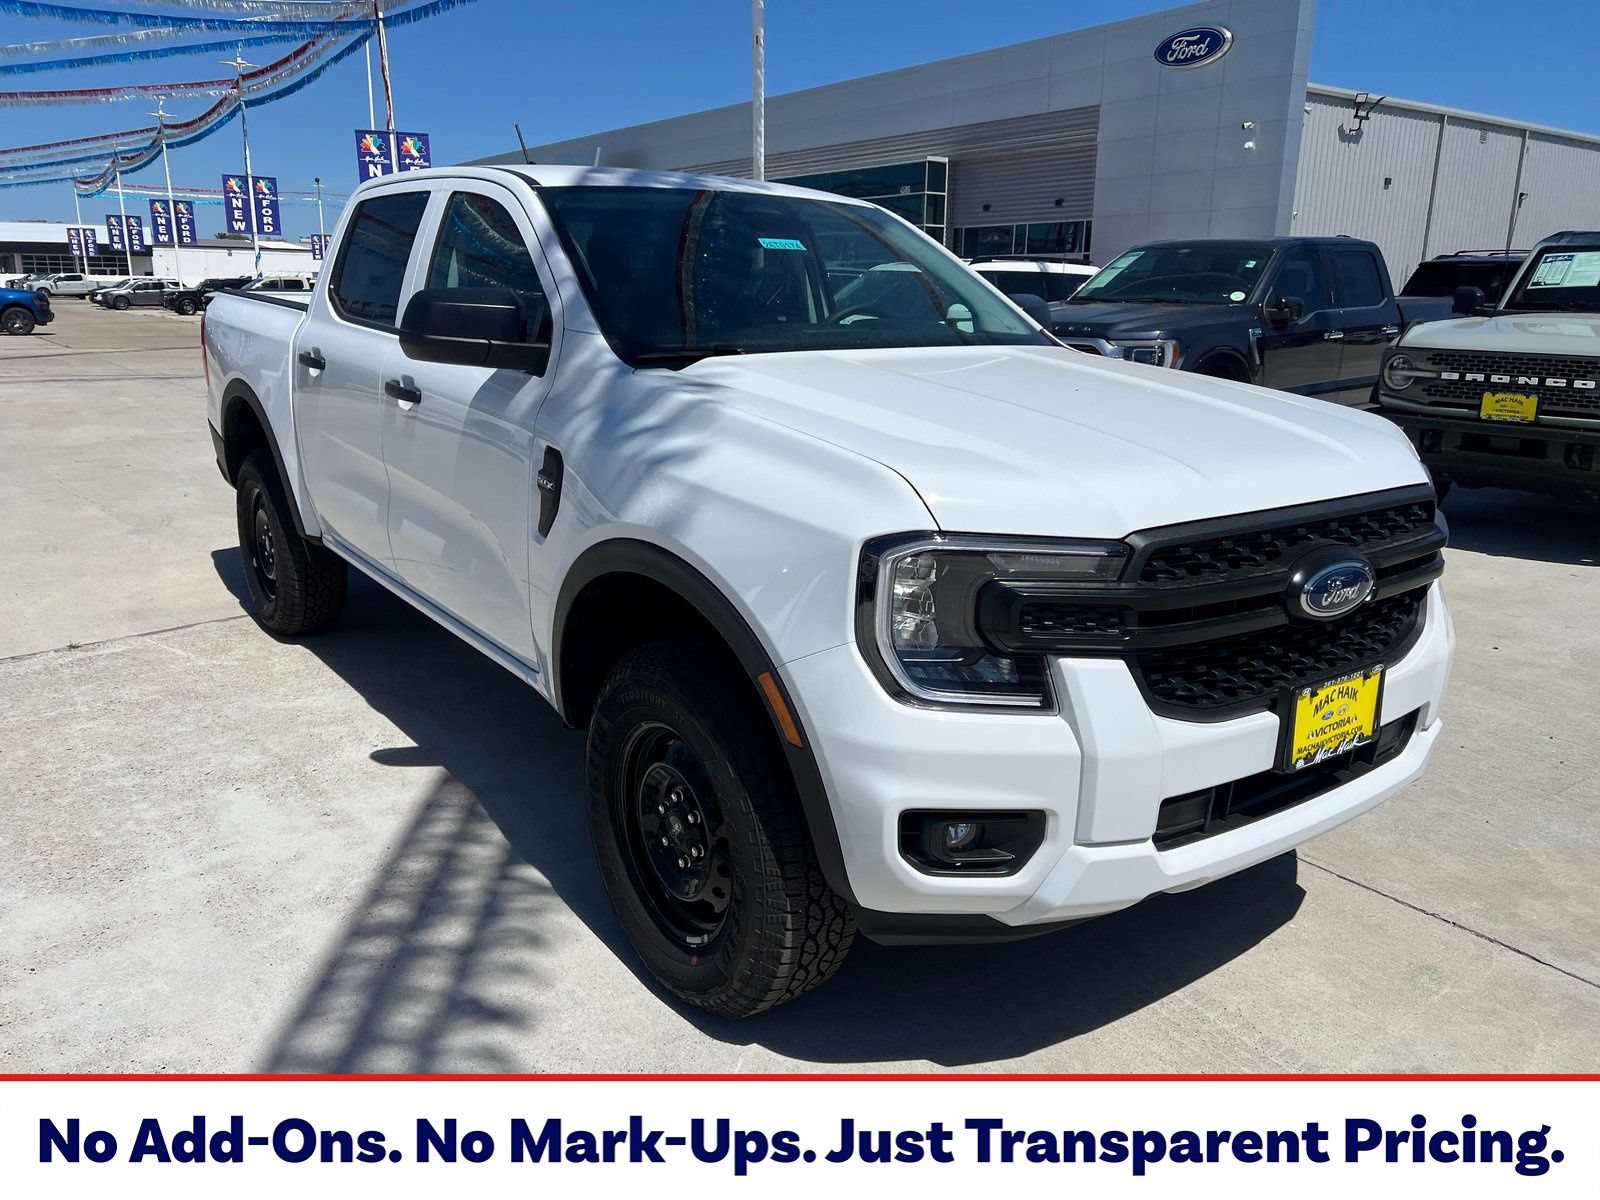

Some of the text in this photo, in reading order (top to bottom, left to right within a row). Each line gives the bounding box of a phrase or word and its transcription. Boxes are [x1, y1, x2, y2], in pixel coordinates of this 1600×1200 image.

[1167, 34, 1211, 62] Ford
[231, 197, 246, 231] NEW
[261, 199, 274, 233] FORD
[111, 229, 122, 250] NEW
[131, 229, 141, 250] FORD
[156, 216, 169, 242] NEW
[181, 217, 191, 243] FORD
[71, 239, 80, 256] NEW
[87, 239, 95, 256] FORD
[1440, 371, 1596, 389] BRONCO
[1321, 574, 1361, 607] Ford
[1313, 689, 1337, 718] MAC
[1337, 686, 1359, 702] HAIK
[1297, 724, 1364, 754] MACHAIKVICTORIA.COM
[1314, 716, 1351, 738] VICTORIA
